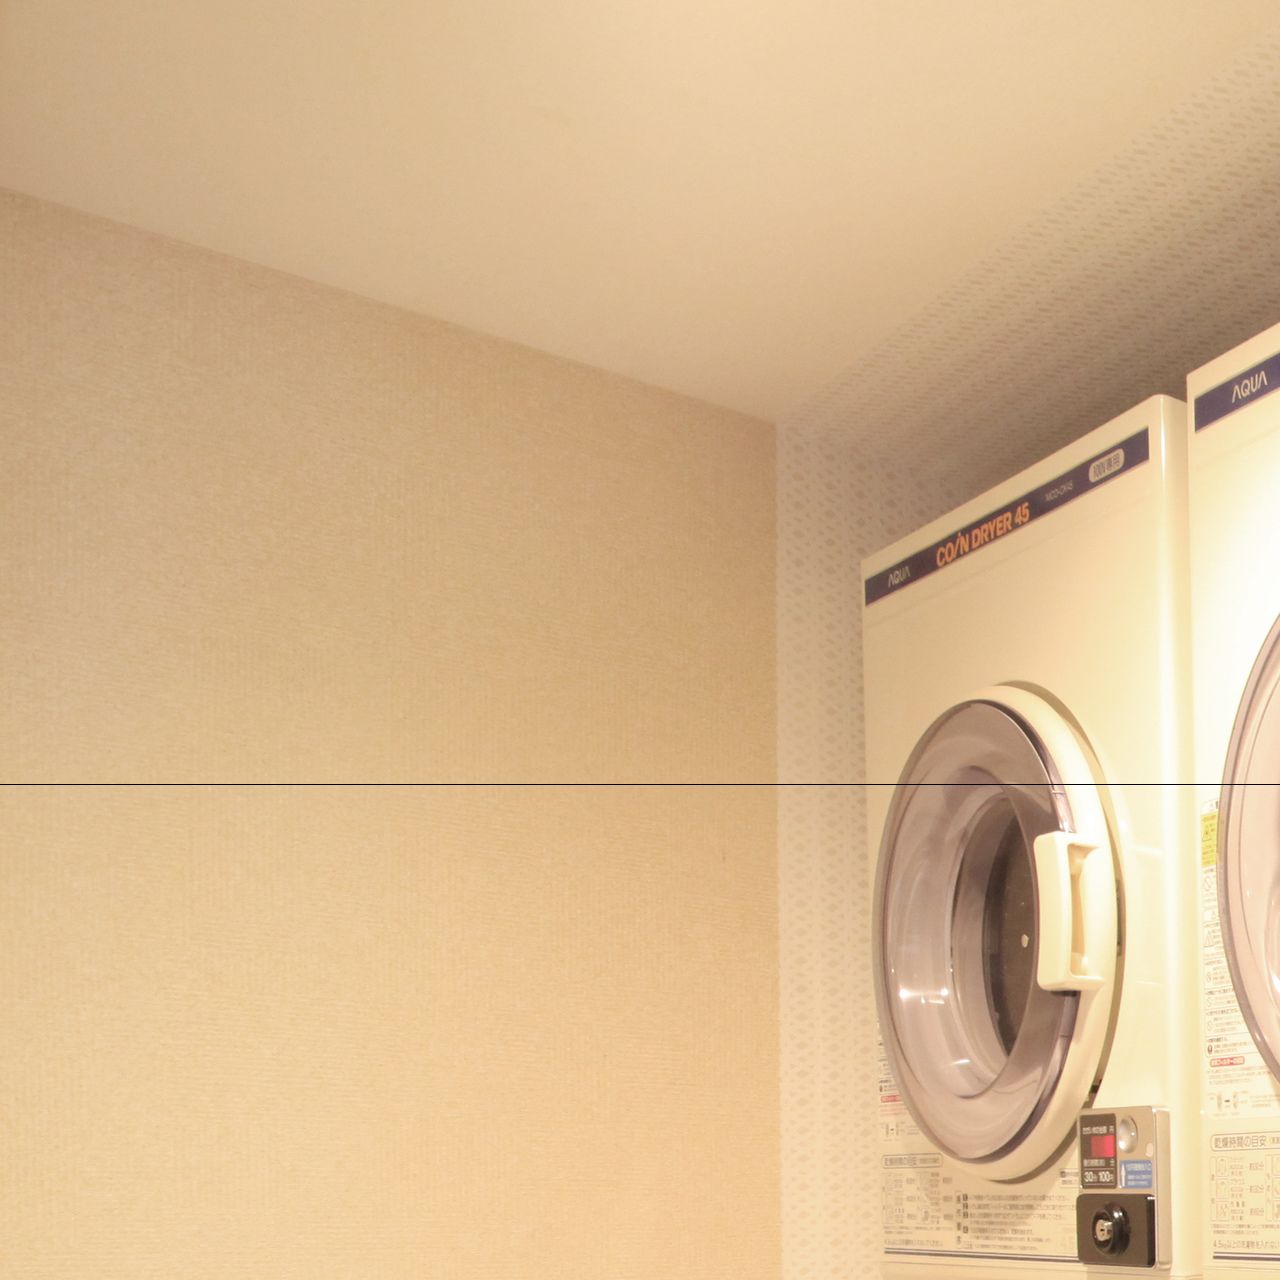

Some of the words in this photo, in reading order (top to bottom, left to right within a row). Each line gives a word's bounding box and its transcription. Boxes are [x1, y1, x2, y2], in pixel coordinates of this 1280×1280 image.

[1231, 370, 1268, 403] AQUA
[888, 565, 911, 588] AQUA
[970, 514, 1013, 550] DRYER
[1014, 502, 1031, 525] 45
